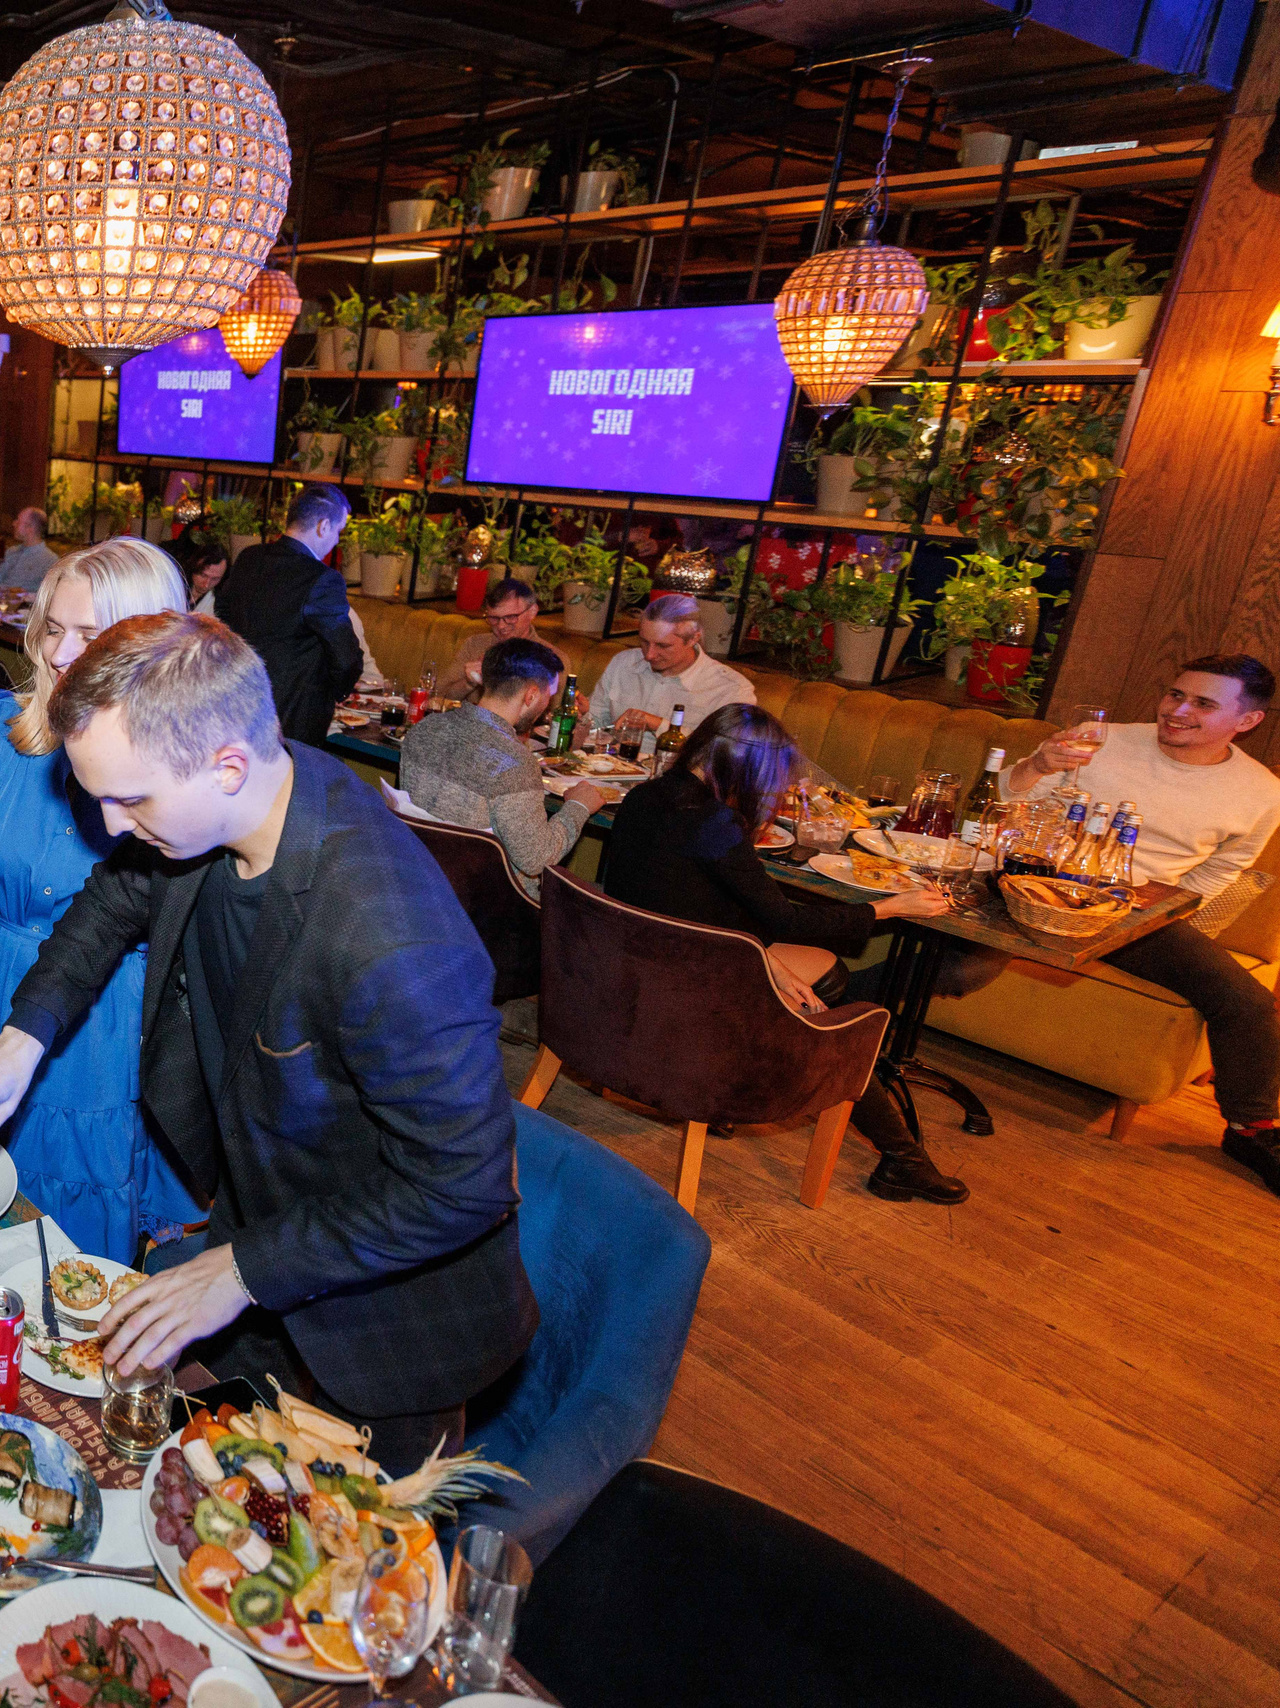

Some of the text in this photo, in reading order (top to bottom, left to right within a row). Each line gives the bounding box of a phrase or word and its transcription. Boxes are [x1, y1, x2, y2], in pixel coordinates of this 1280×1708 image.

[157, 370, 232, 392] НОВОГОДНЯЯ
[548, 368, 695, 400] НОВОГОДНЯЯ
[181, 398, 203, 418] SIRI
[591, 409, 634, 435] SIRI
